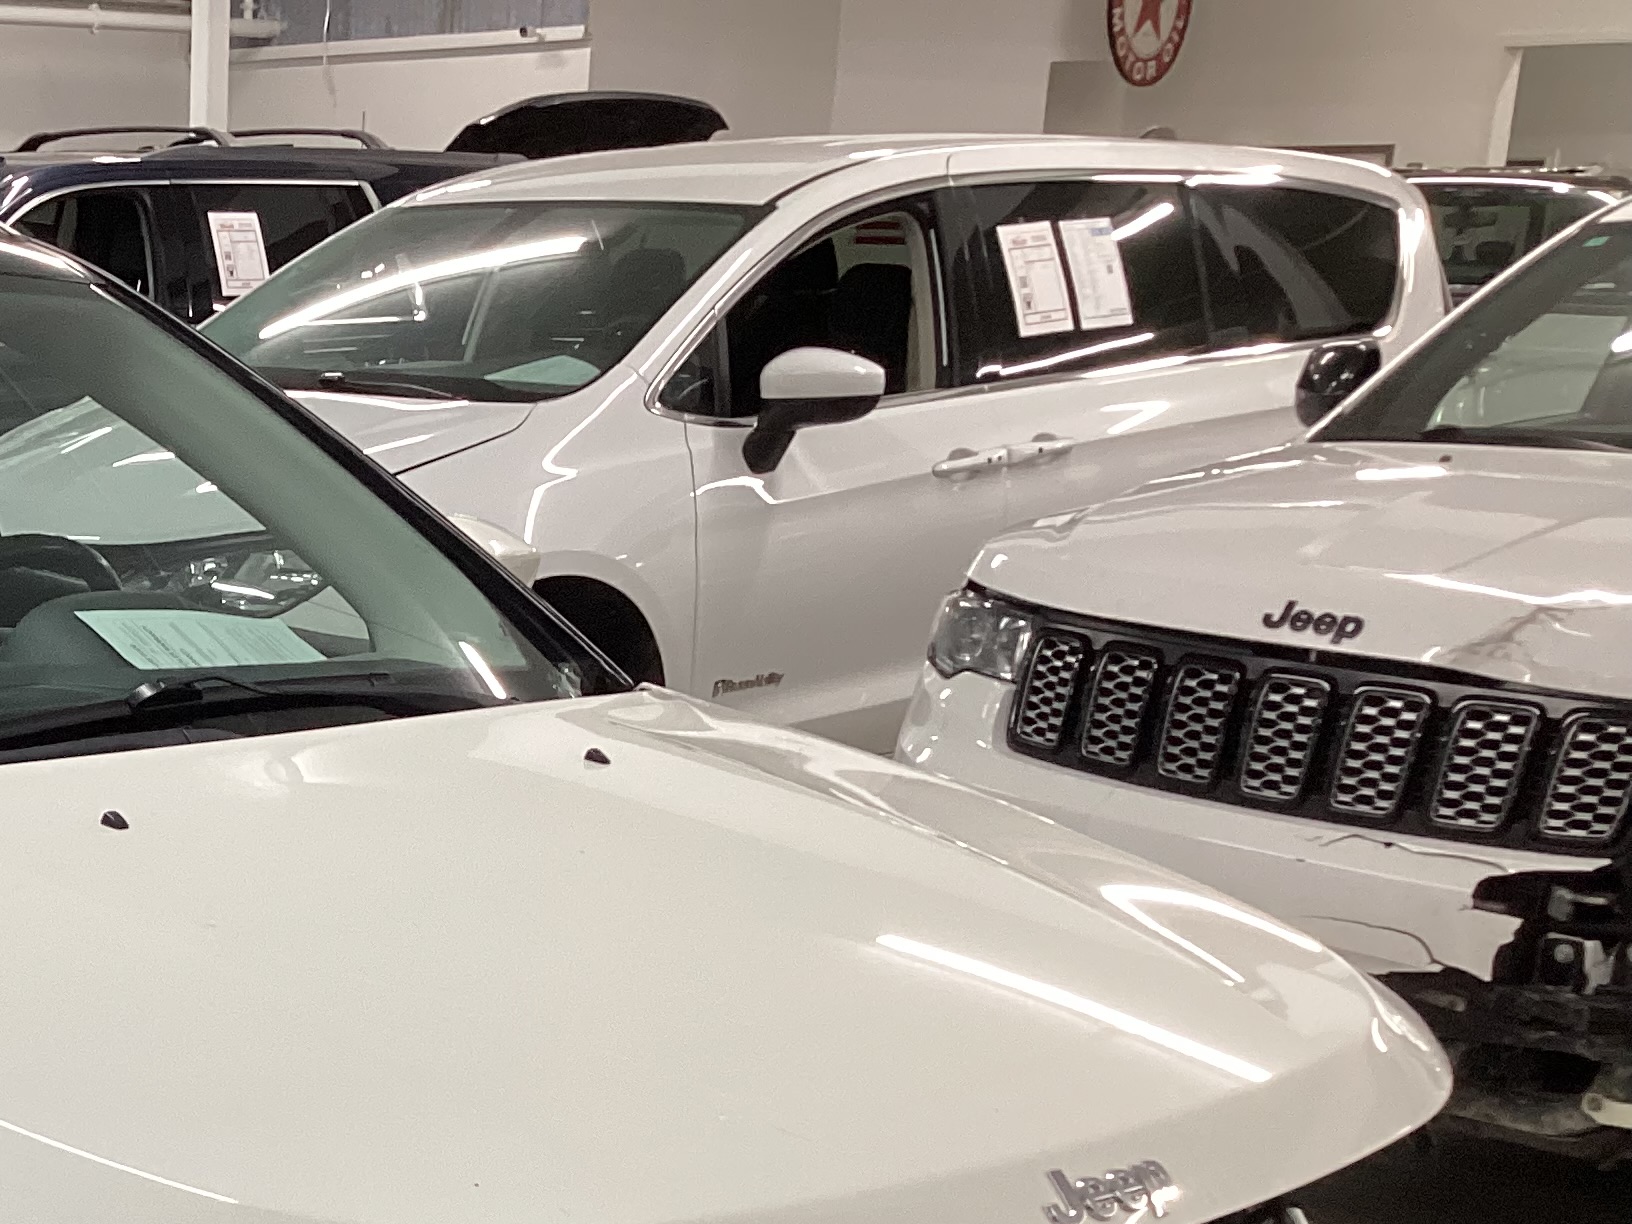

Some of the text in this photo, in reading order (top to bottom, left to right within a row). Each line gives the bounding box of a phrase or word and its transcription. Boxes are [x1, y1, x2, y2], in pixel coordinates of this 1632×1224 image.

[1112, 7, 1185, 81] MOTOR OIL
[1262, 600, 1365, 645] Jeep
